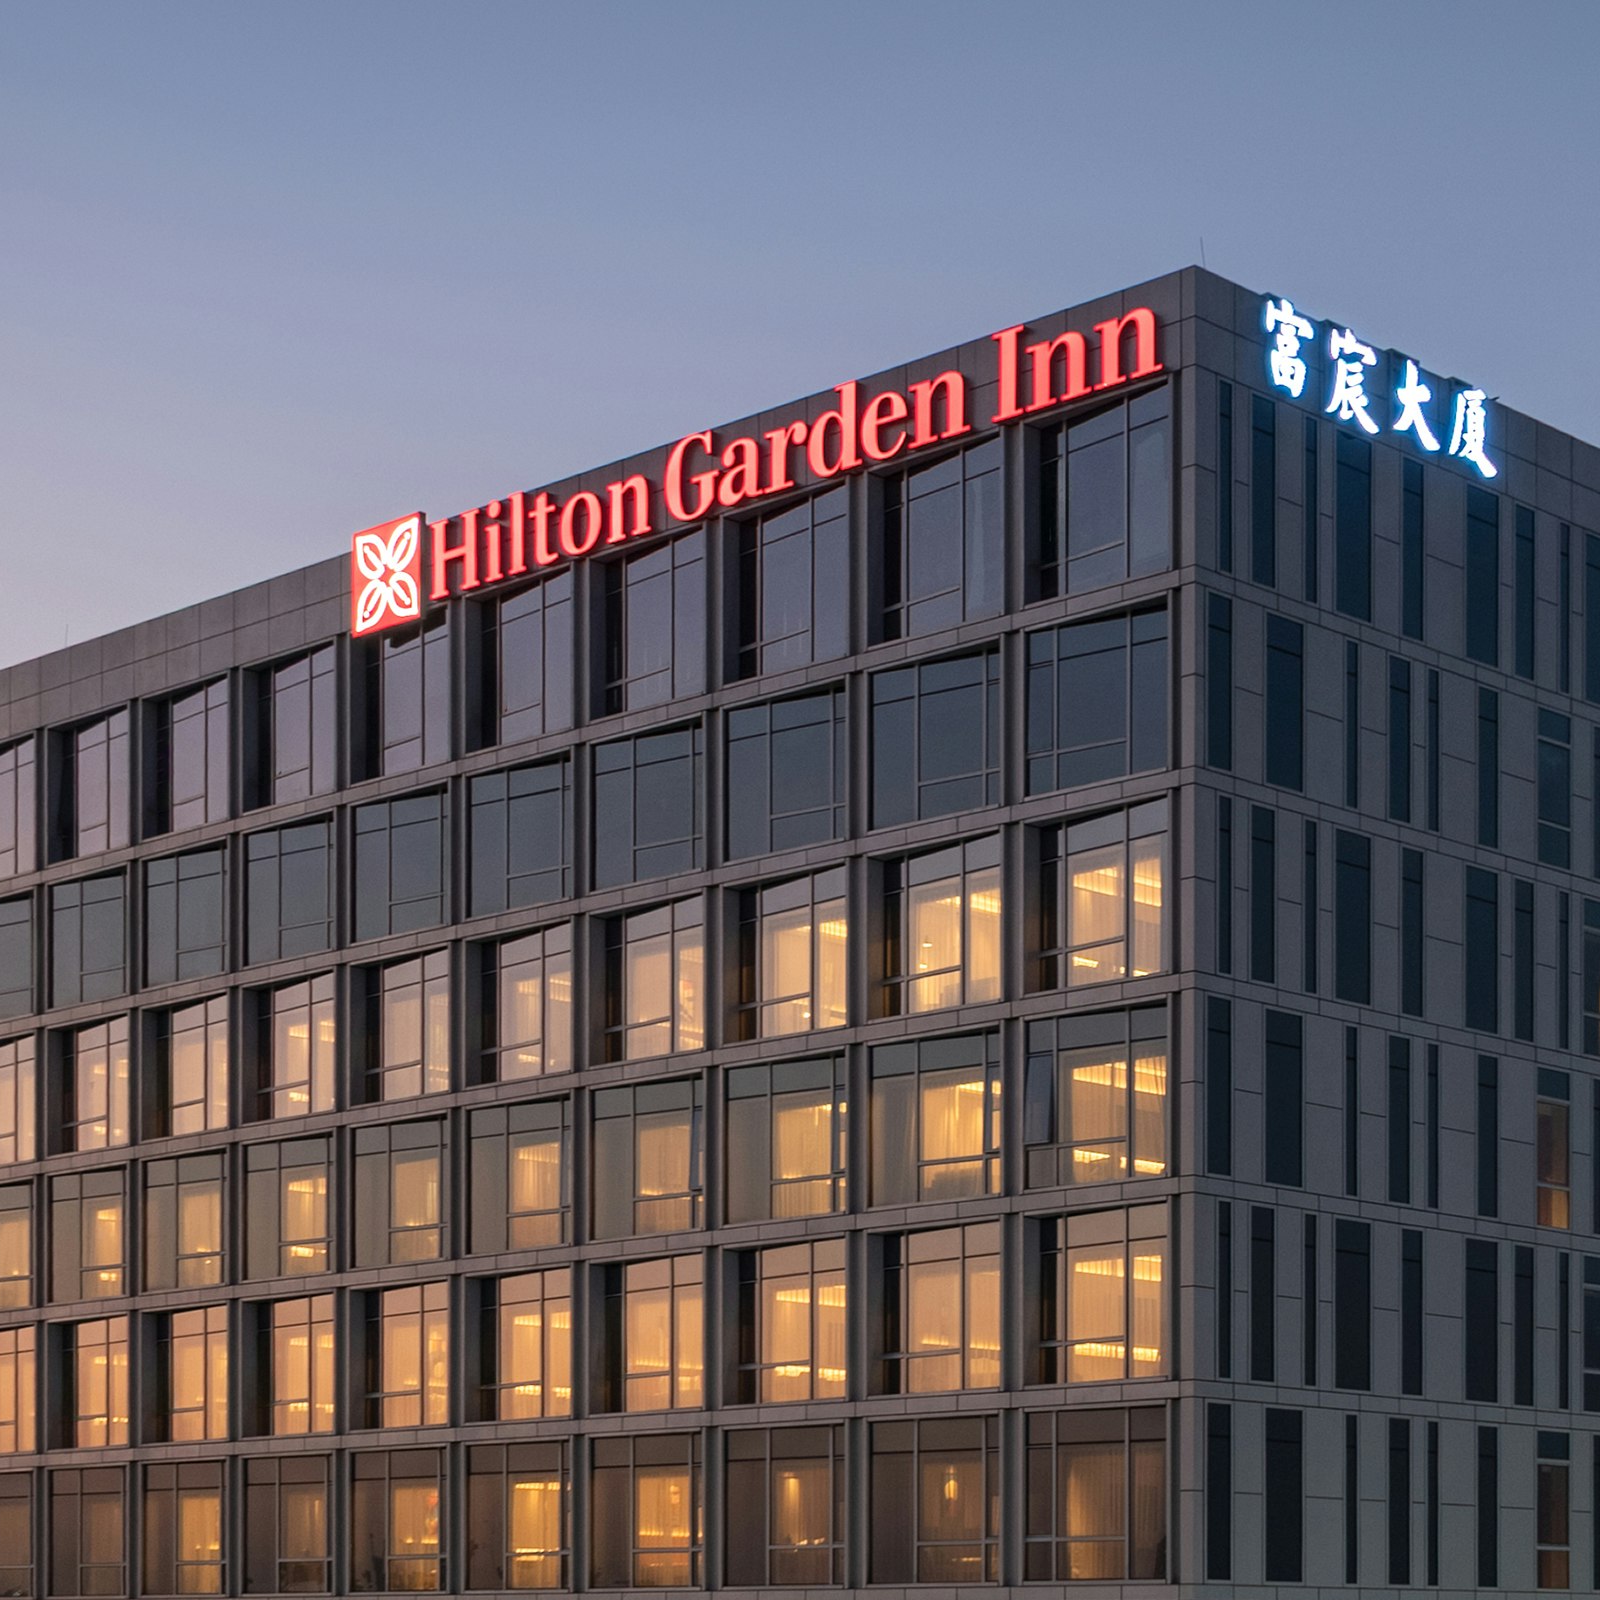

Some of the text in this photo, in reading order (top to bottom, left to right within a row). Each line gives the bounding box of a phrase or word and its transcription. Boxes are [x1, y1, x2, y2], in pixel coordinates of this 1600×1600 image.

[427, 306, 1165, 603] Hilton Garden Inn
[1264, 299, 1497, 478] 富宸大厦
